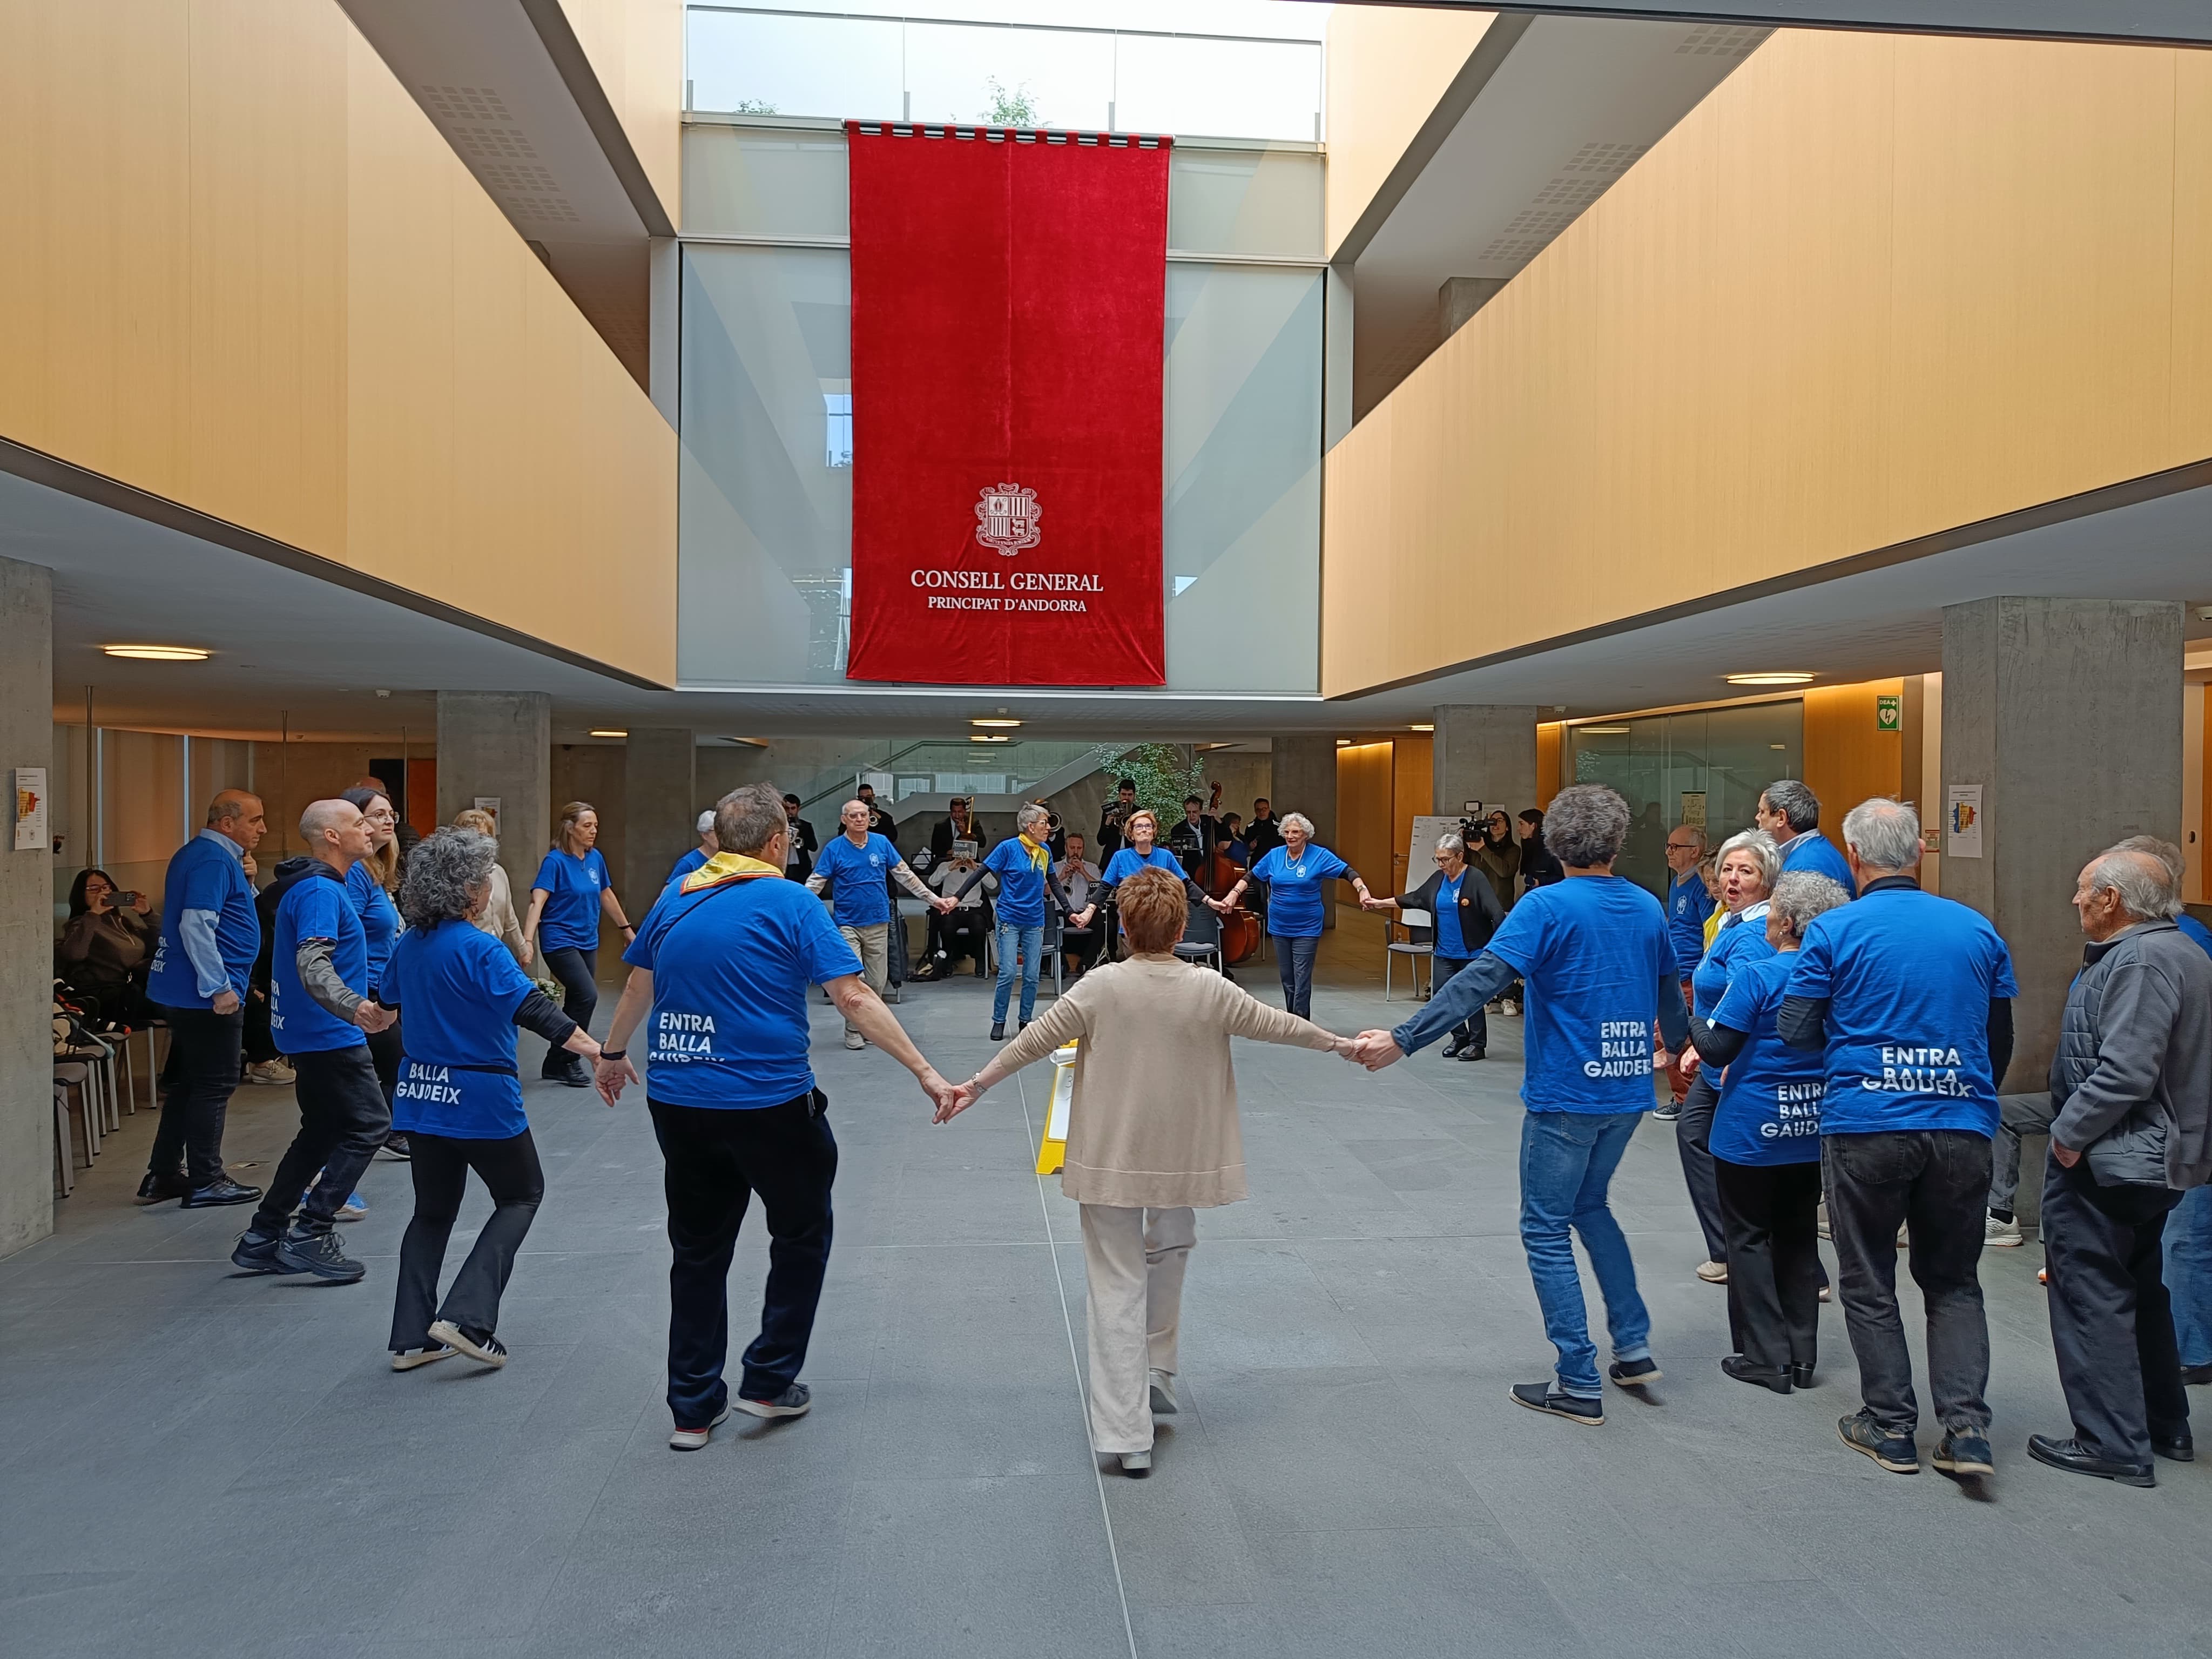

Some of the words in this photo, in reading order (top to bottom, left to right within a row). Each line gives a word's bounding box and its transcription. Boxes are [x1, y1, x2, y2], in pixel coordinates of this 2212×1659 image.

[911, 570, 1005, 590] CONSELL
[1010, 573, 1104, 591] GENERAL
[928, 596, 1001, 610] PRINCIPAT
[1004, 599, 1087, 612] D'ANDORRA
[659, 1012, 716, 1033] ENTRA
[1601, 1021, 1647, 1038] ENTRA
[659, 1033, 711, 1054] BALLA
[1601, 1041, 1647, 1058] BALLA
[1882, 1047, 1961, 1065] ENTRA
[409, 1063, 449, 1083] BALLA
[1862, 1077, 1973, 1097] GAUDEIX
[1779, 1102, 1821, 1119] BALL
[1761, 1120, 1818, 1138] GAUD
